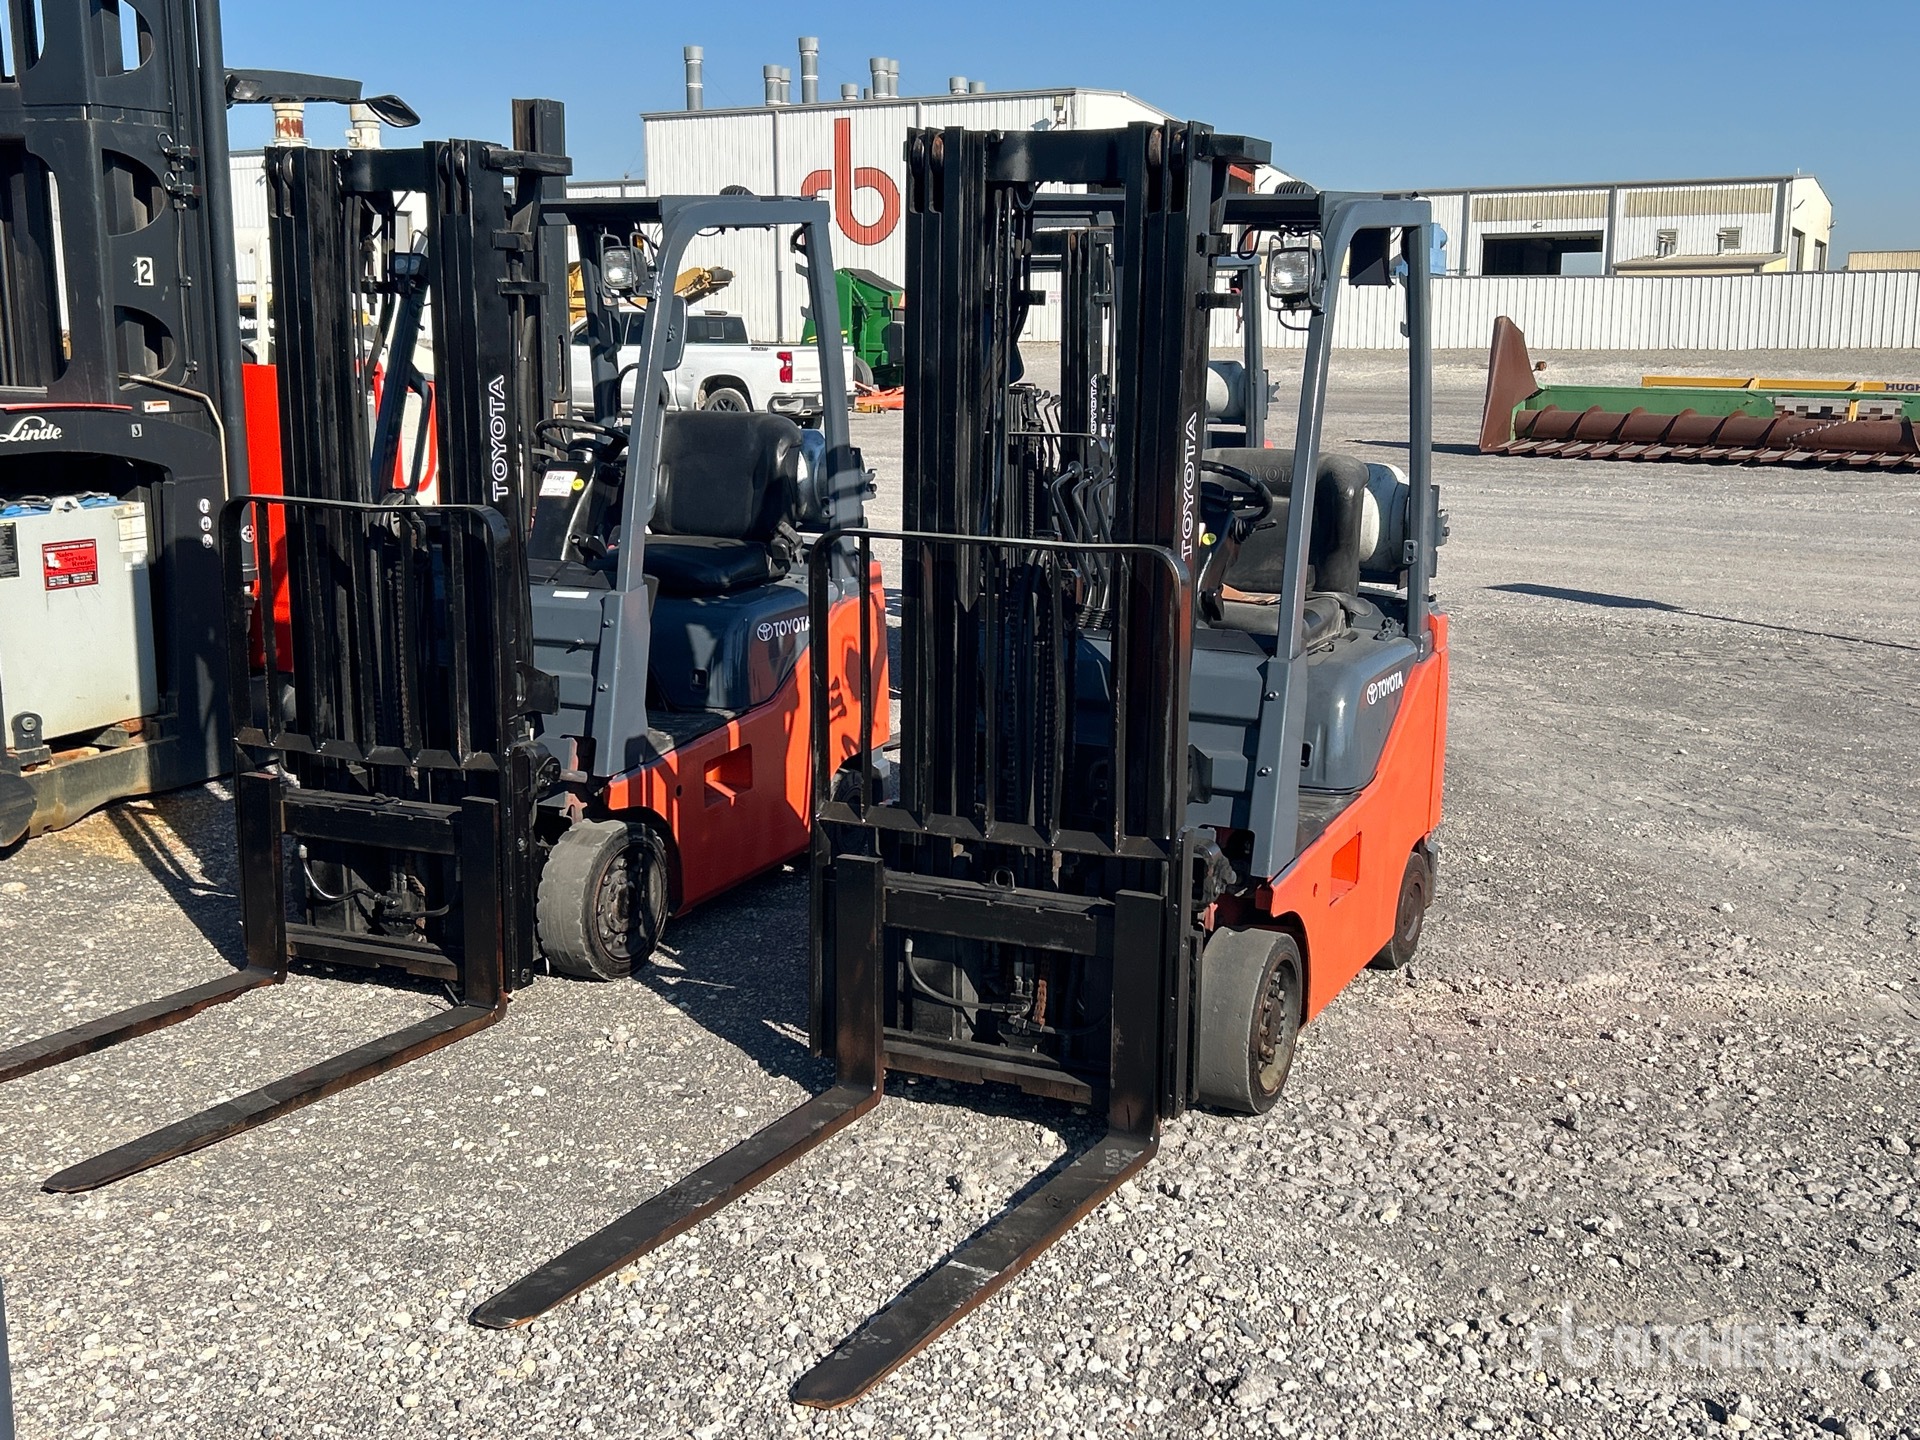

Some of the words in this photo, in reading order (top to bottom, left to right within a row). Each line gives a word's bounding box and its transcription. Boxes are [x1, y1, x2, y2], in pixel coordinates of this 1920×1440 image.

[140, 260, 151, 283] 2
[0, 415, 63, 443] Linde
[488, 374, 509, 502] TOYOTA
[1181, 411, 1197, 562] TOYOTA
[773, 616, 810, 637] TOYOTA
[1377, 670, 1404, 699] TOYOTA
